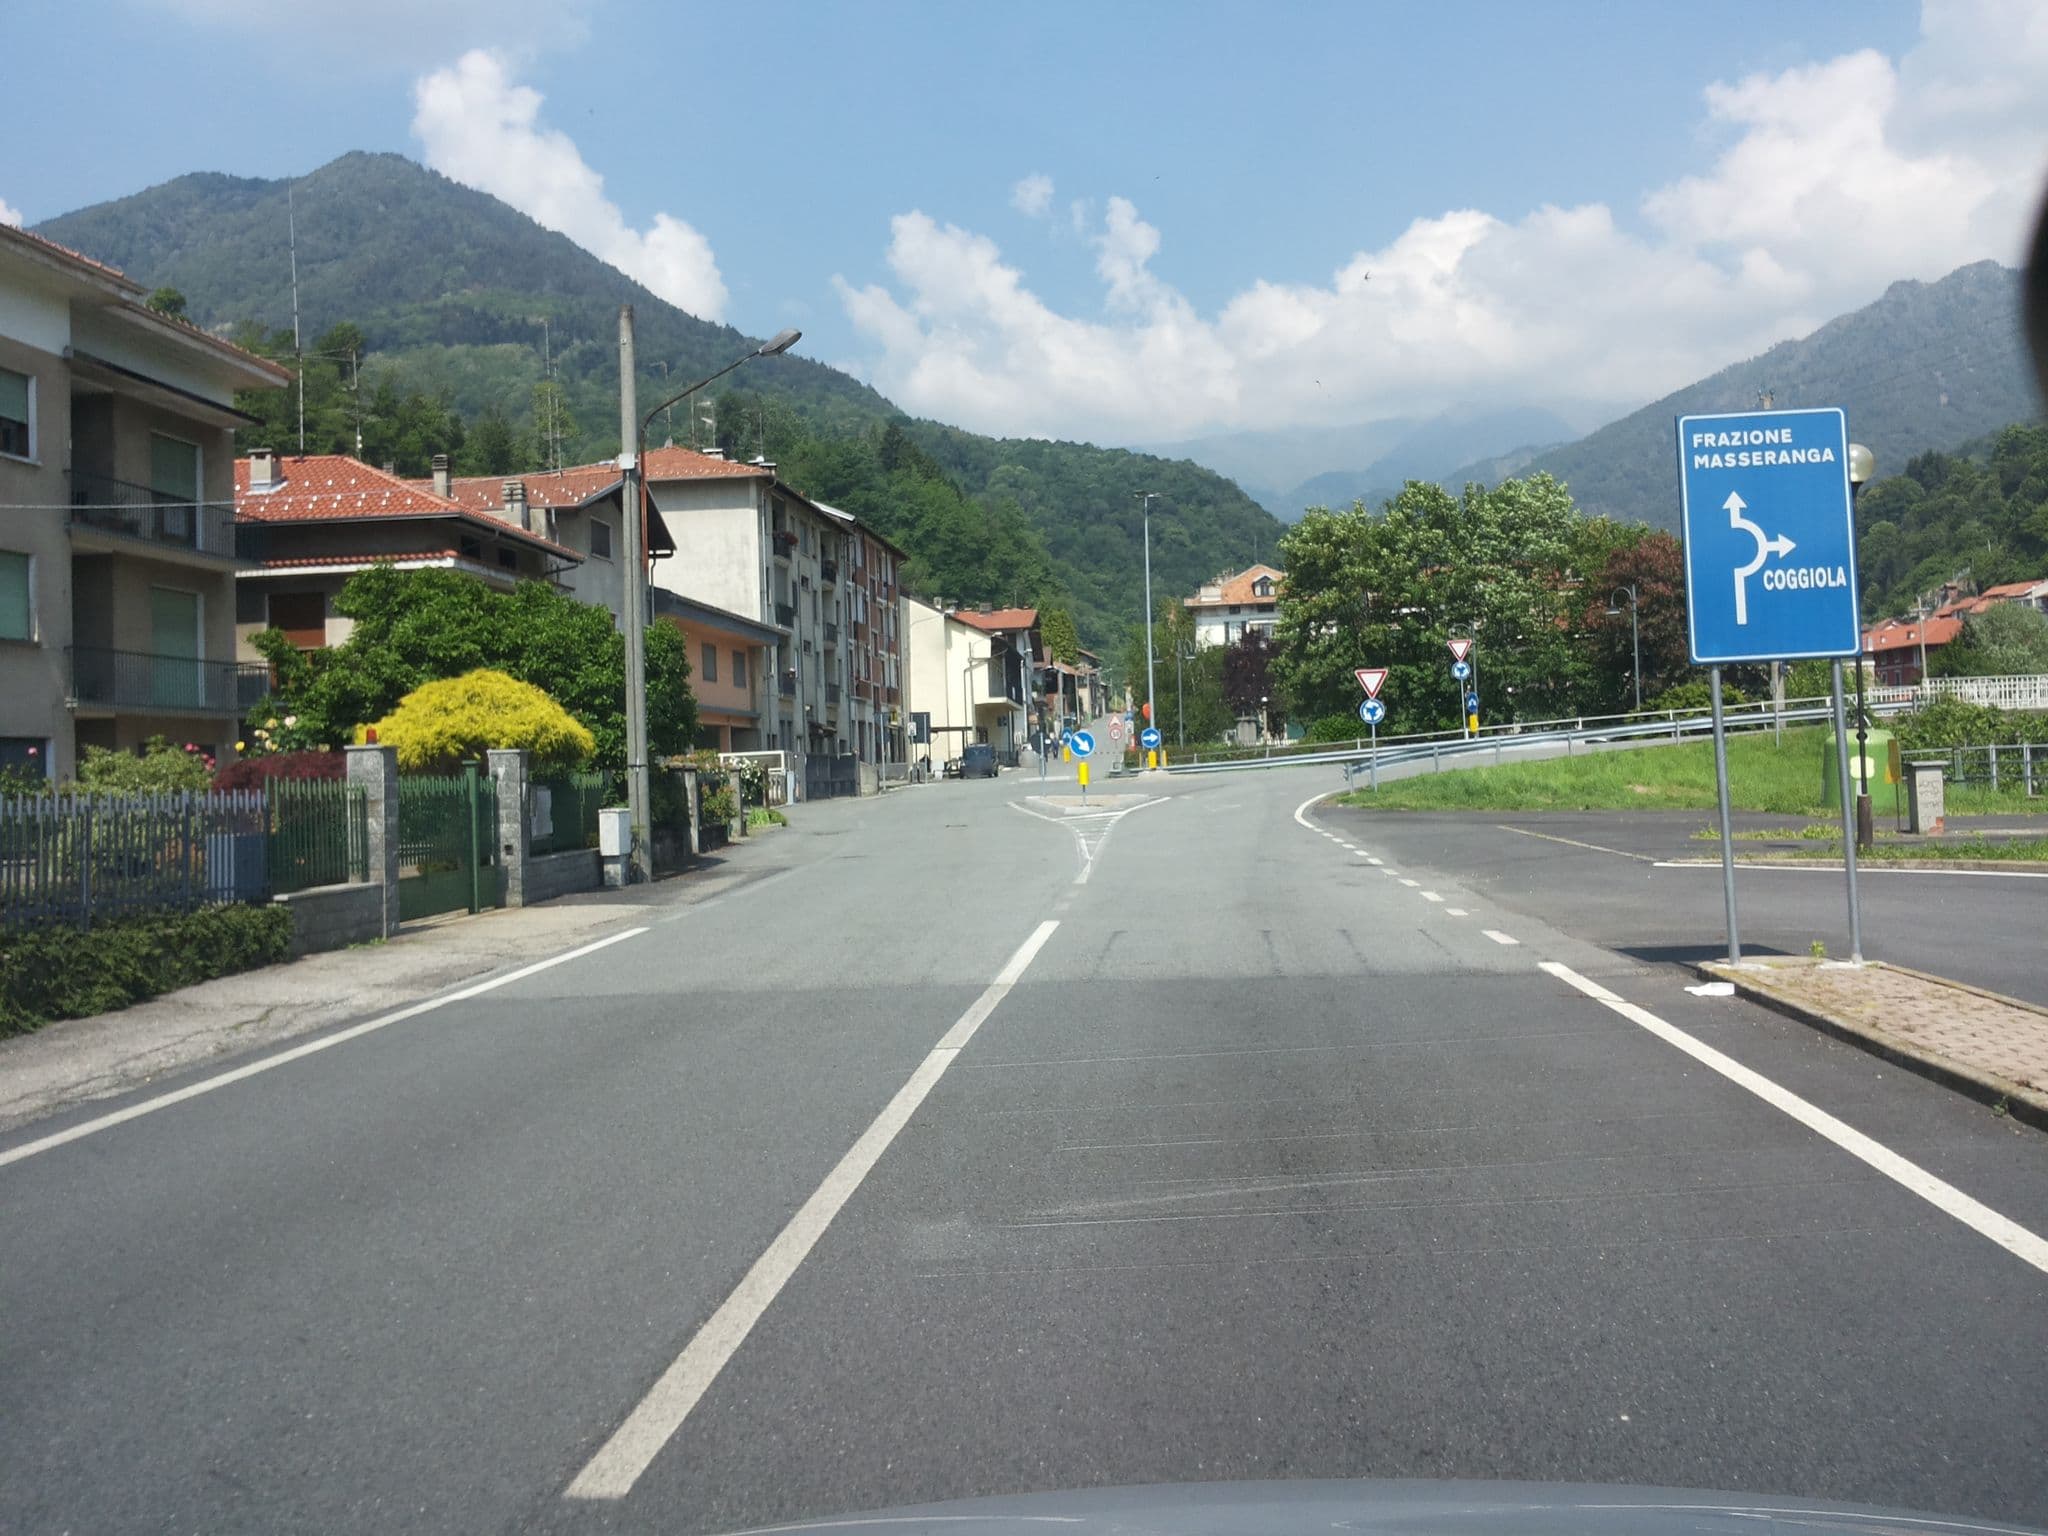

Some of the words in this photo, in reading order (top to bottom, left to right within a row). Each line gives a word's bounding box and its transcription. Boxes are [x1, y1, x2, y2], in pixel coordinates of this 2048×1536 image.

[1692, 428, 1793, 448] FRAZIONE
[1693, 447, 1835, 469] MASSERANGA
[1763, 566, 1847, 590] COGGIOLA
